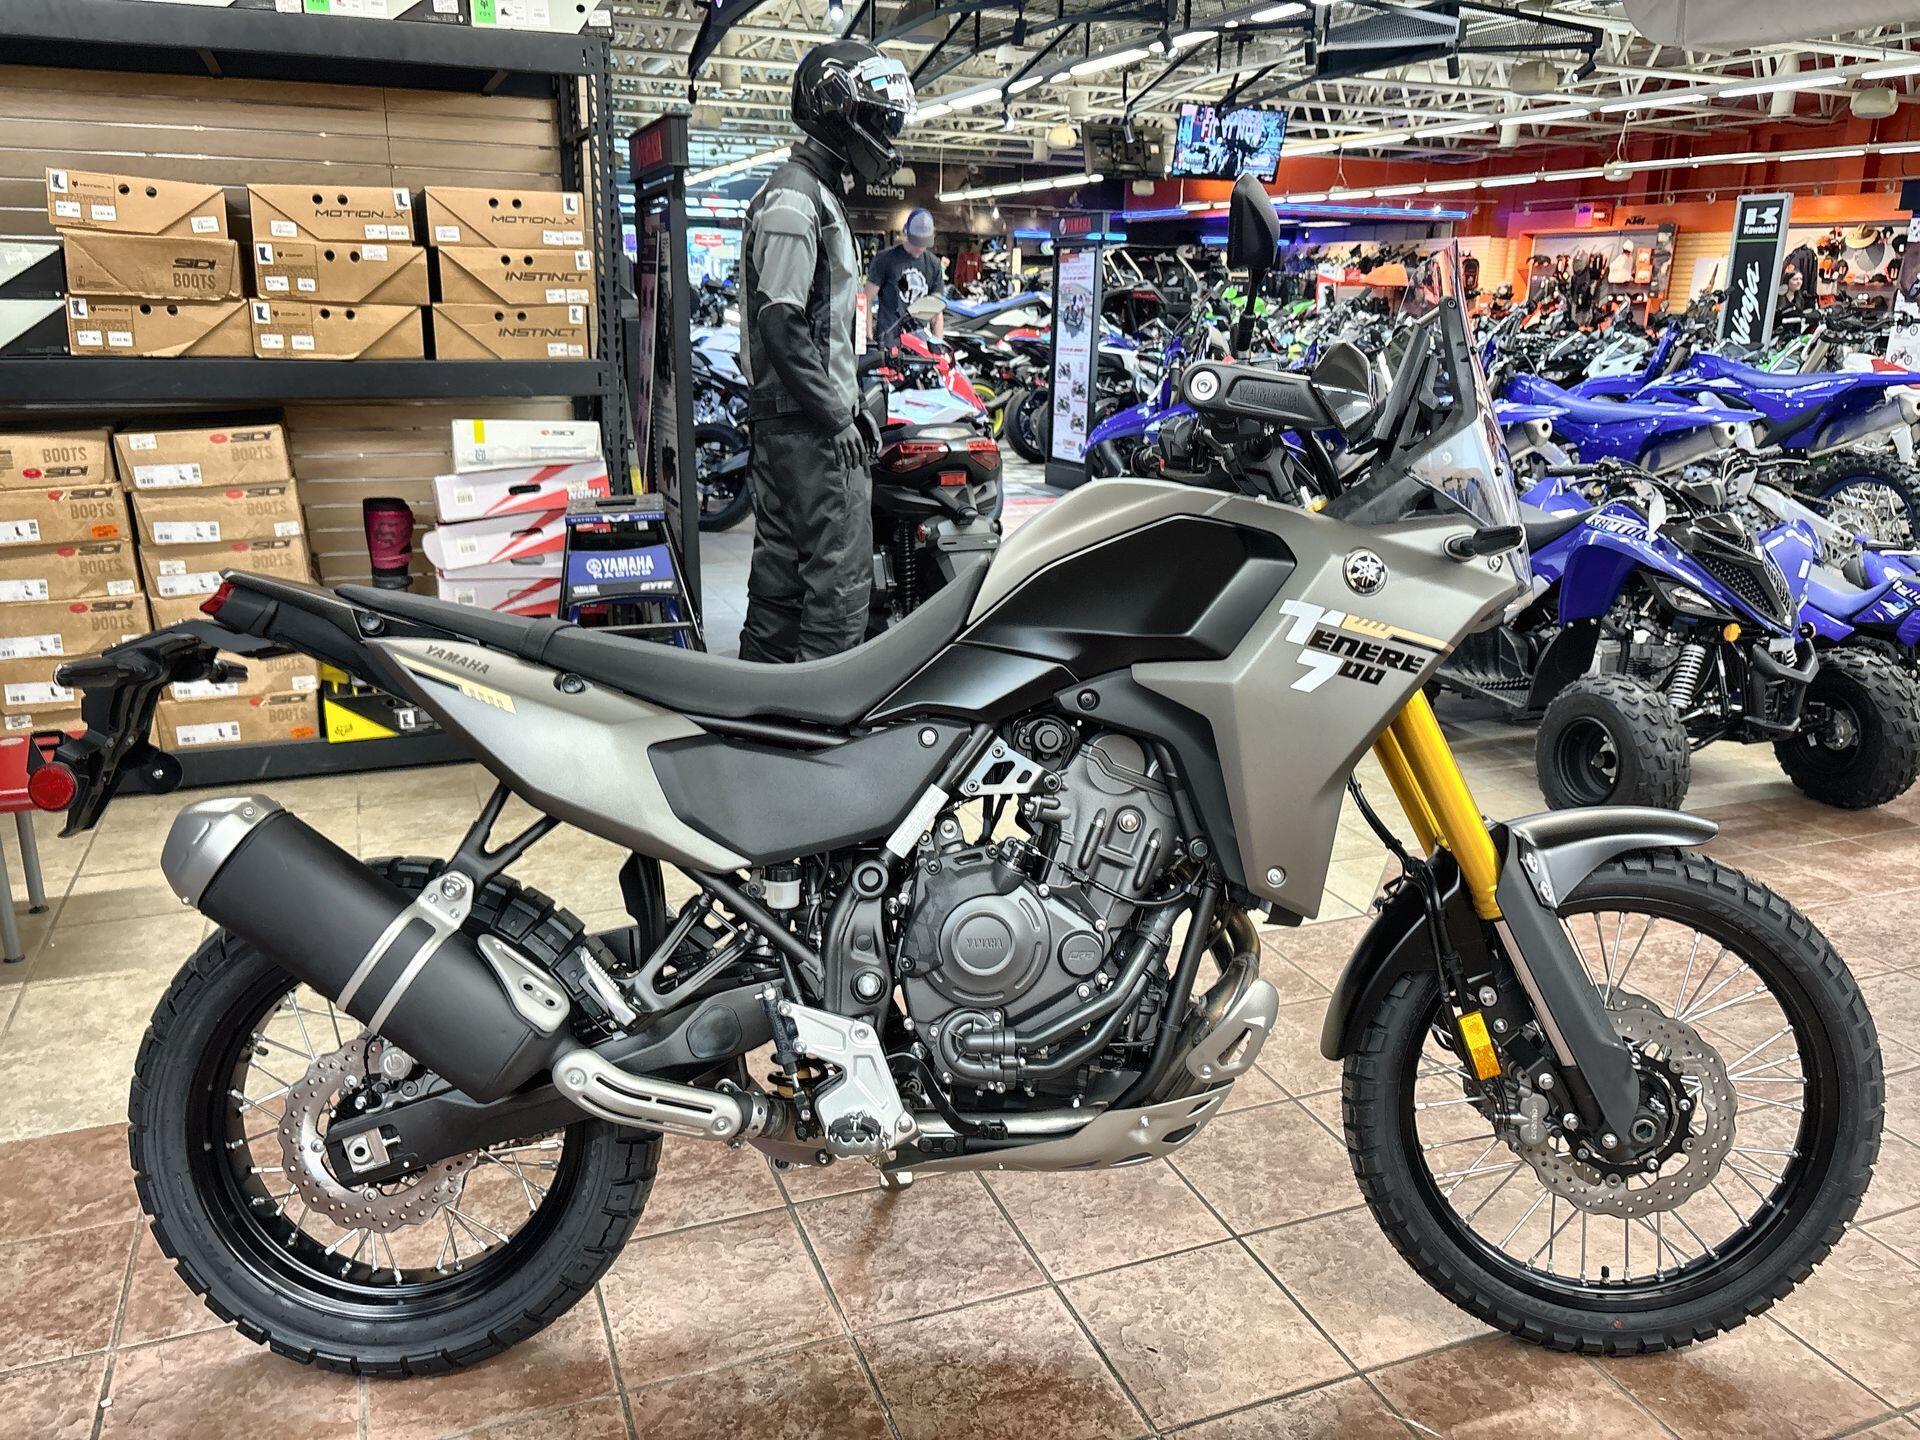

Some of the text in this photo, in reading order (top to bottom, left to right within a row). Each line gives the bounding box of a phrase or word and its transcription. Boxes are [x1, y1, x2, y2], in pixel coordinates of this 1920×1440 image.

[866, 184, 905, 200] Racing
[1743, 224, 1778, 235] Kawasaki
[172, 257, 217, 271] SIDI
[172, 272, 217, 290] BOOTS
[504, 271, 588, 283] INSTINCT
[1730, 260, 1761, 345] Ninja
[498, 327, 581, 338] INSTINCT
[1239, 383, 1301, 409] YAMAHA
[42, 446, 88, 463] BOOTS
[231, 446, 274, 462] BOOTS
[69, 502, 116, 520] BOOTS
[246, 500, 288, 516] BOOTS
[79, 558, 124, 575] BOOTS
[252, 552, 294, 569] BOOTS
[601, 555, 655, 573] YAMAHA
[592, 569, 653, 580] RACING
[91, 614, 136, 631] BOOTS
[425, 644, 491, 675] YAMAHA
[1289, 648, 1388, 694] 700
[268, 705, 308, 723] BOOTS
[966, 937, 1003, 949] YAMAHA
